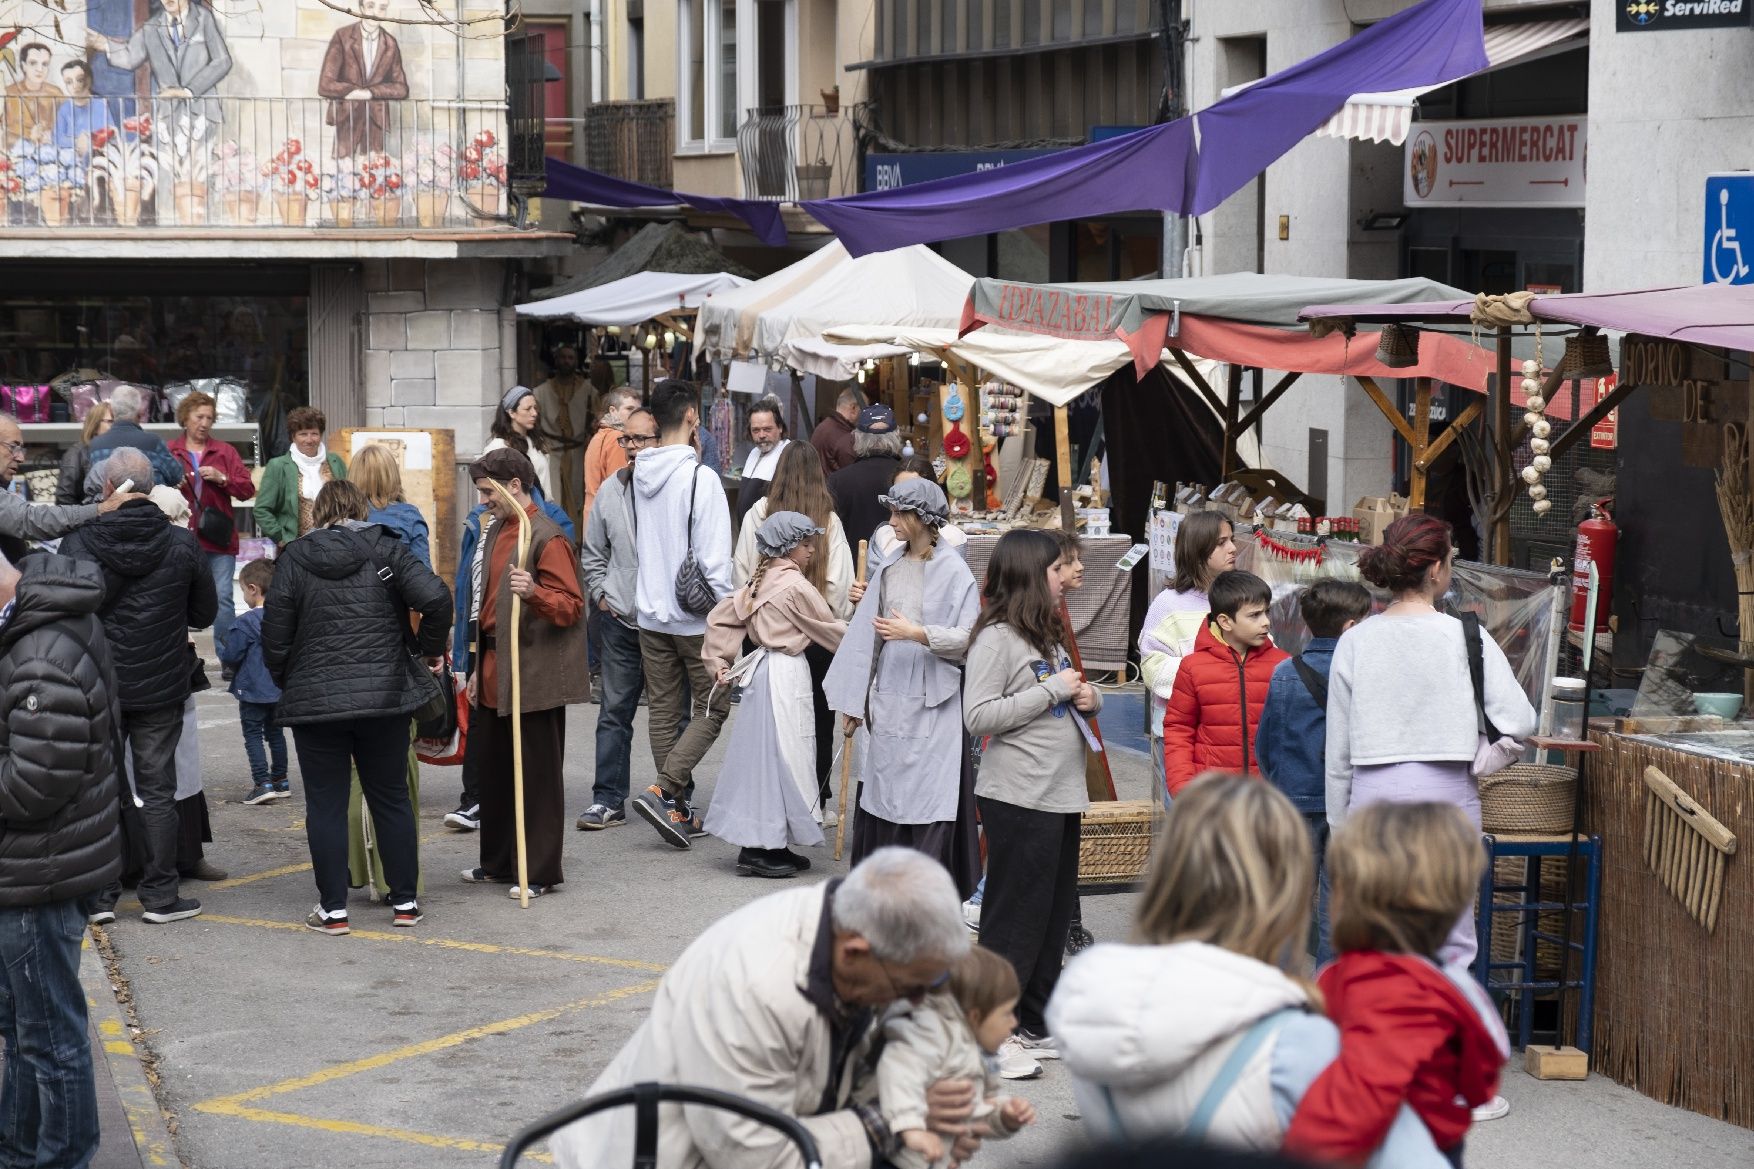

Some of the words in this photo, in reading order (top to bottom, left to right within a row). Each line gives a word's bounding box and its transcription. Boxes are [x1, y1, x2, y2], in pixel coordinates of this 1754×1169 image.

[1664, 0, 1742, 16] ServiRed
[1444, 124, 1578, 164] SUPERMERCAT
[876, 162, 902, 191] BBVA
[1625, 342, 1681, 387] HORNO
[1683, 379, 1708, 423] DE
